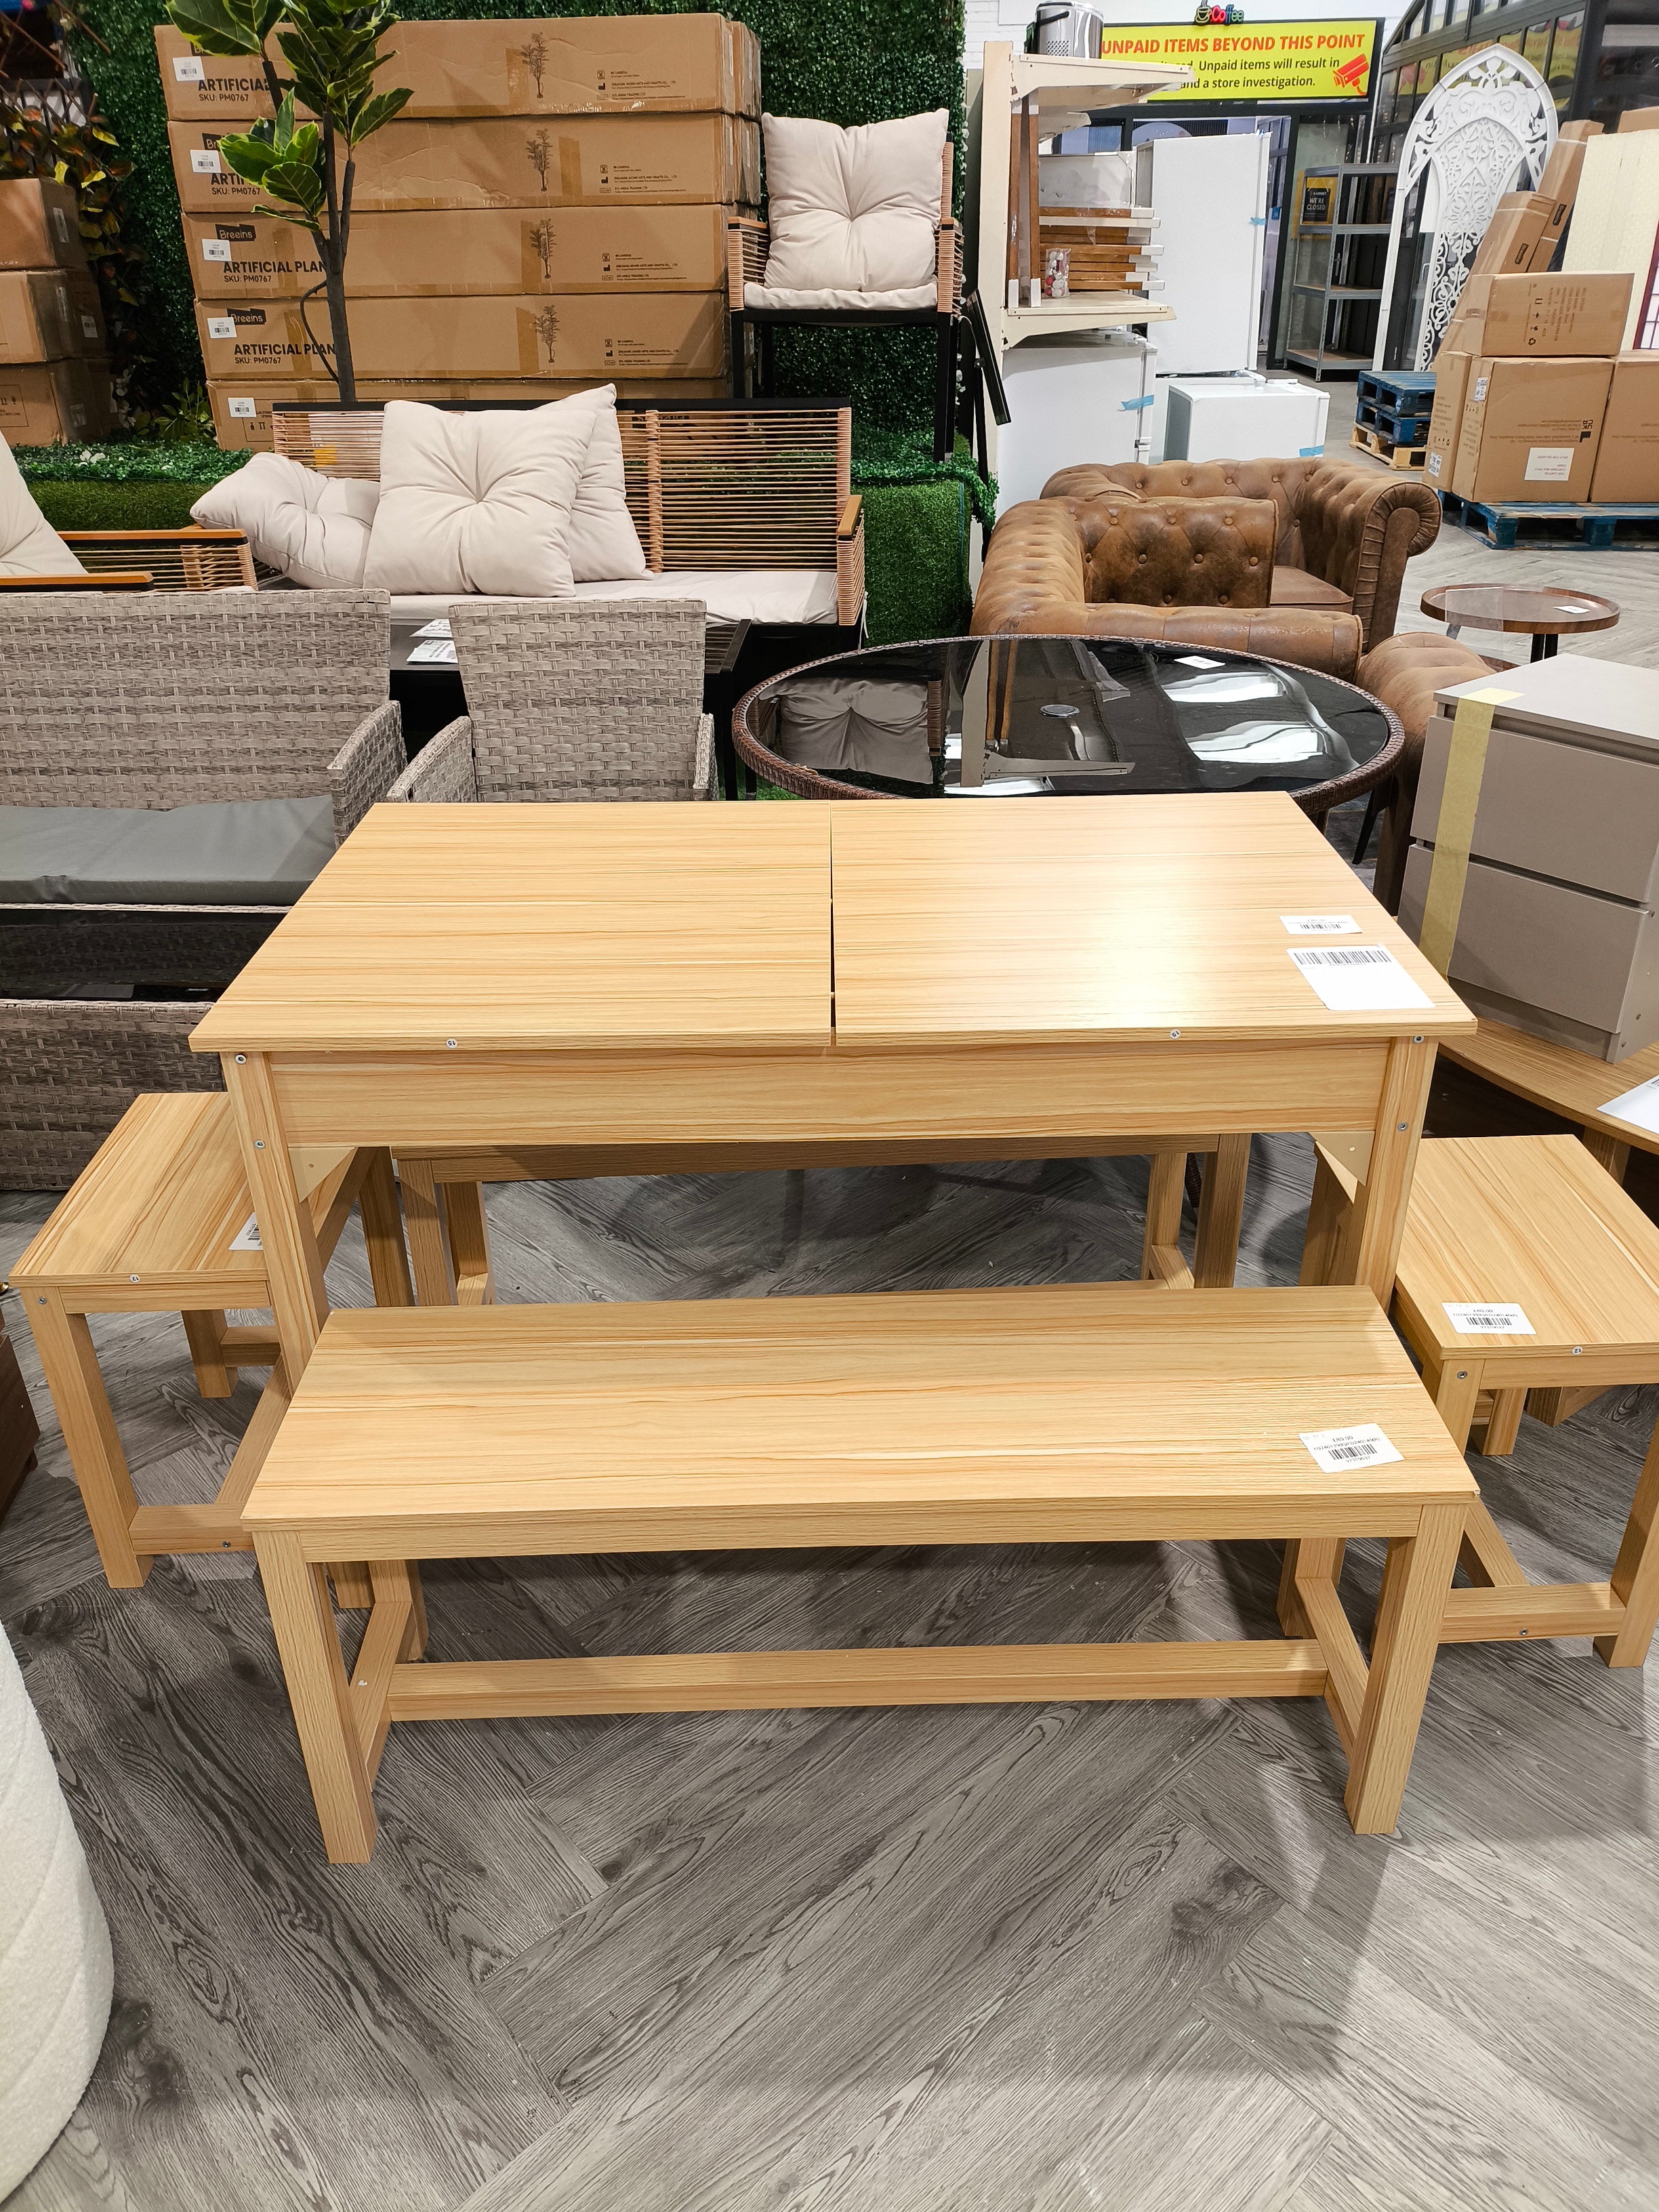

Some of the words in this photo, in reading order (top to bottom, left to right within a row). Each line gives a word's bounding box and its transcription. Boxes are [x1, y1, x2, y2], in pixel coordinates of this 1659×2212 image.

[1212, 5, 1244, 23] Coffee
[1102, 39, 1160, 54] UNPAID
[1164, 38, 1209, 53] ITEMS
[1212, 37, 1275, 52] BEYOND
[1279, 35, 1313, 49] THIS
[1317, 34, 1365, 49] POINT
[1199, 60, 1237, 73] Unpaid
[1240, 59, 1271, 70] items
[1273, 58, 1292, 68] will
[1295, 58, 1327, 68] result
[1330, 57, 1340, 67] in
[1203, 80, 1209, 88] a
[1212, 78, 1240, 88] store
[1243, 75, 1315, 89] investigation.
[220, 94, 249, 102] PM0767
[219, 229, 253, 239] Breeins
[224, 261, 293, 273] ARTIFICIAL
[295, 261, 326, 272] PLAN
[234, 344, 302, 355] ARTIFICIAL
[304, 344, 336, 355] PLAN
